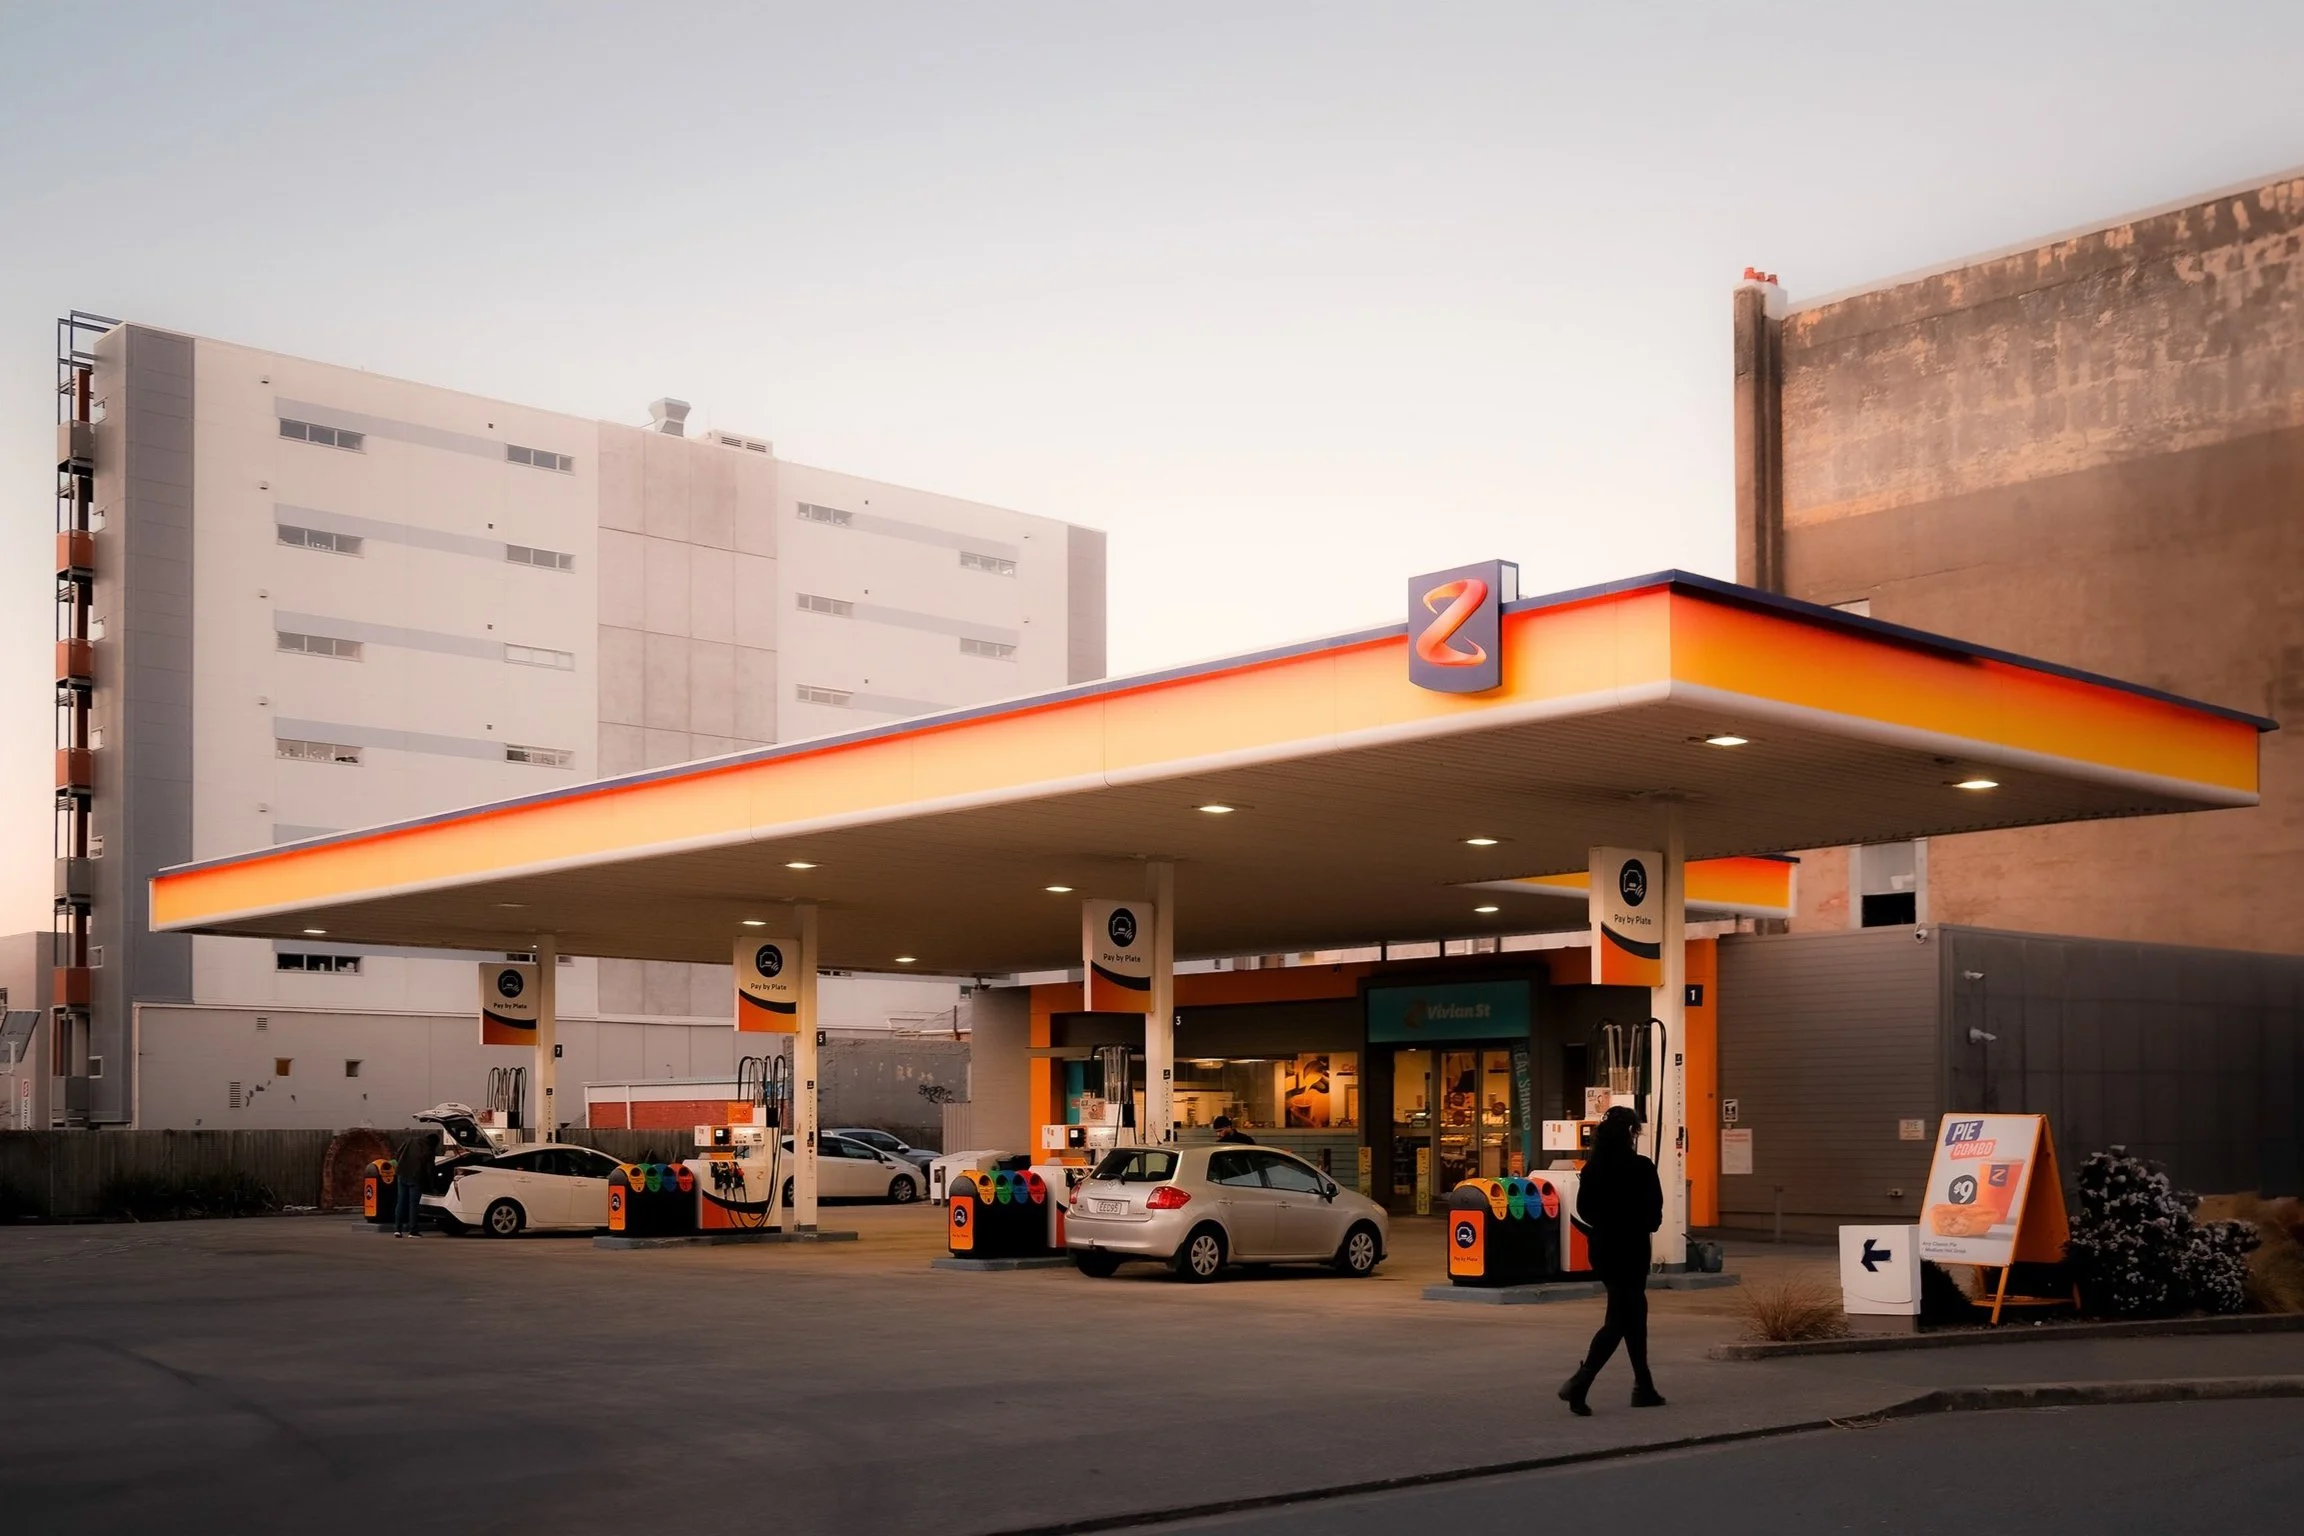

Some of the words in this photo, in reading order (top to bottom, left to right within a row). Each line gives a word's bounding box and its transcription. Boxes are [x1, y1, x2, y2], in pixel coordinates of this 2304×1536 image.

[1415, 578, 1488, 668] Z
[1614, 914, 1625, 924] Pay
[1627, 915, 1635, 924] by
[1636, 915, 1651, 925] Plate
[1103, 953, 1114, 962] Pay
[1116, 953, 1124, 963] by
[1125, 954, 1141, 963] Plate
[763, 983, 770, 991] by
[771, 983, 787, 991] Plate
[1690, 990, 1696, 1001] 1
[505, 1002, 512, 1010] by
[1427, 1003, 1474, 1020] Vivian
[1475, 1003, 1491, 1018] St
[1175, 1015, 1181, 1026] 3
[1951, 1122, 1979, 1141] PIE
[1953, 1142, 1993, 1156] COMBO
[1991, 1168, 2006, 1182] Z
[1953, 1180, 1974, 1203] $9
